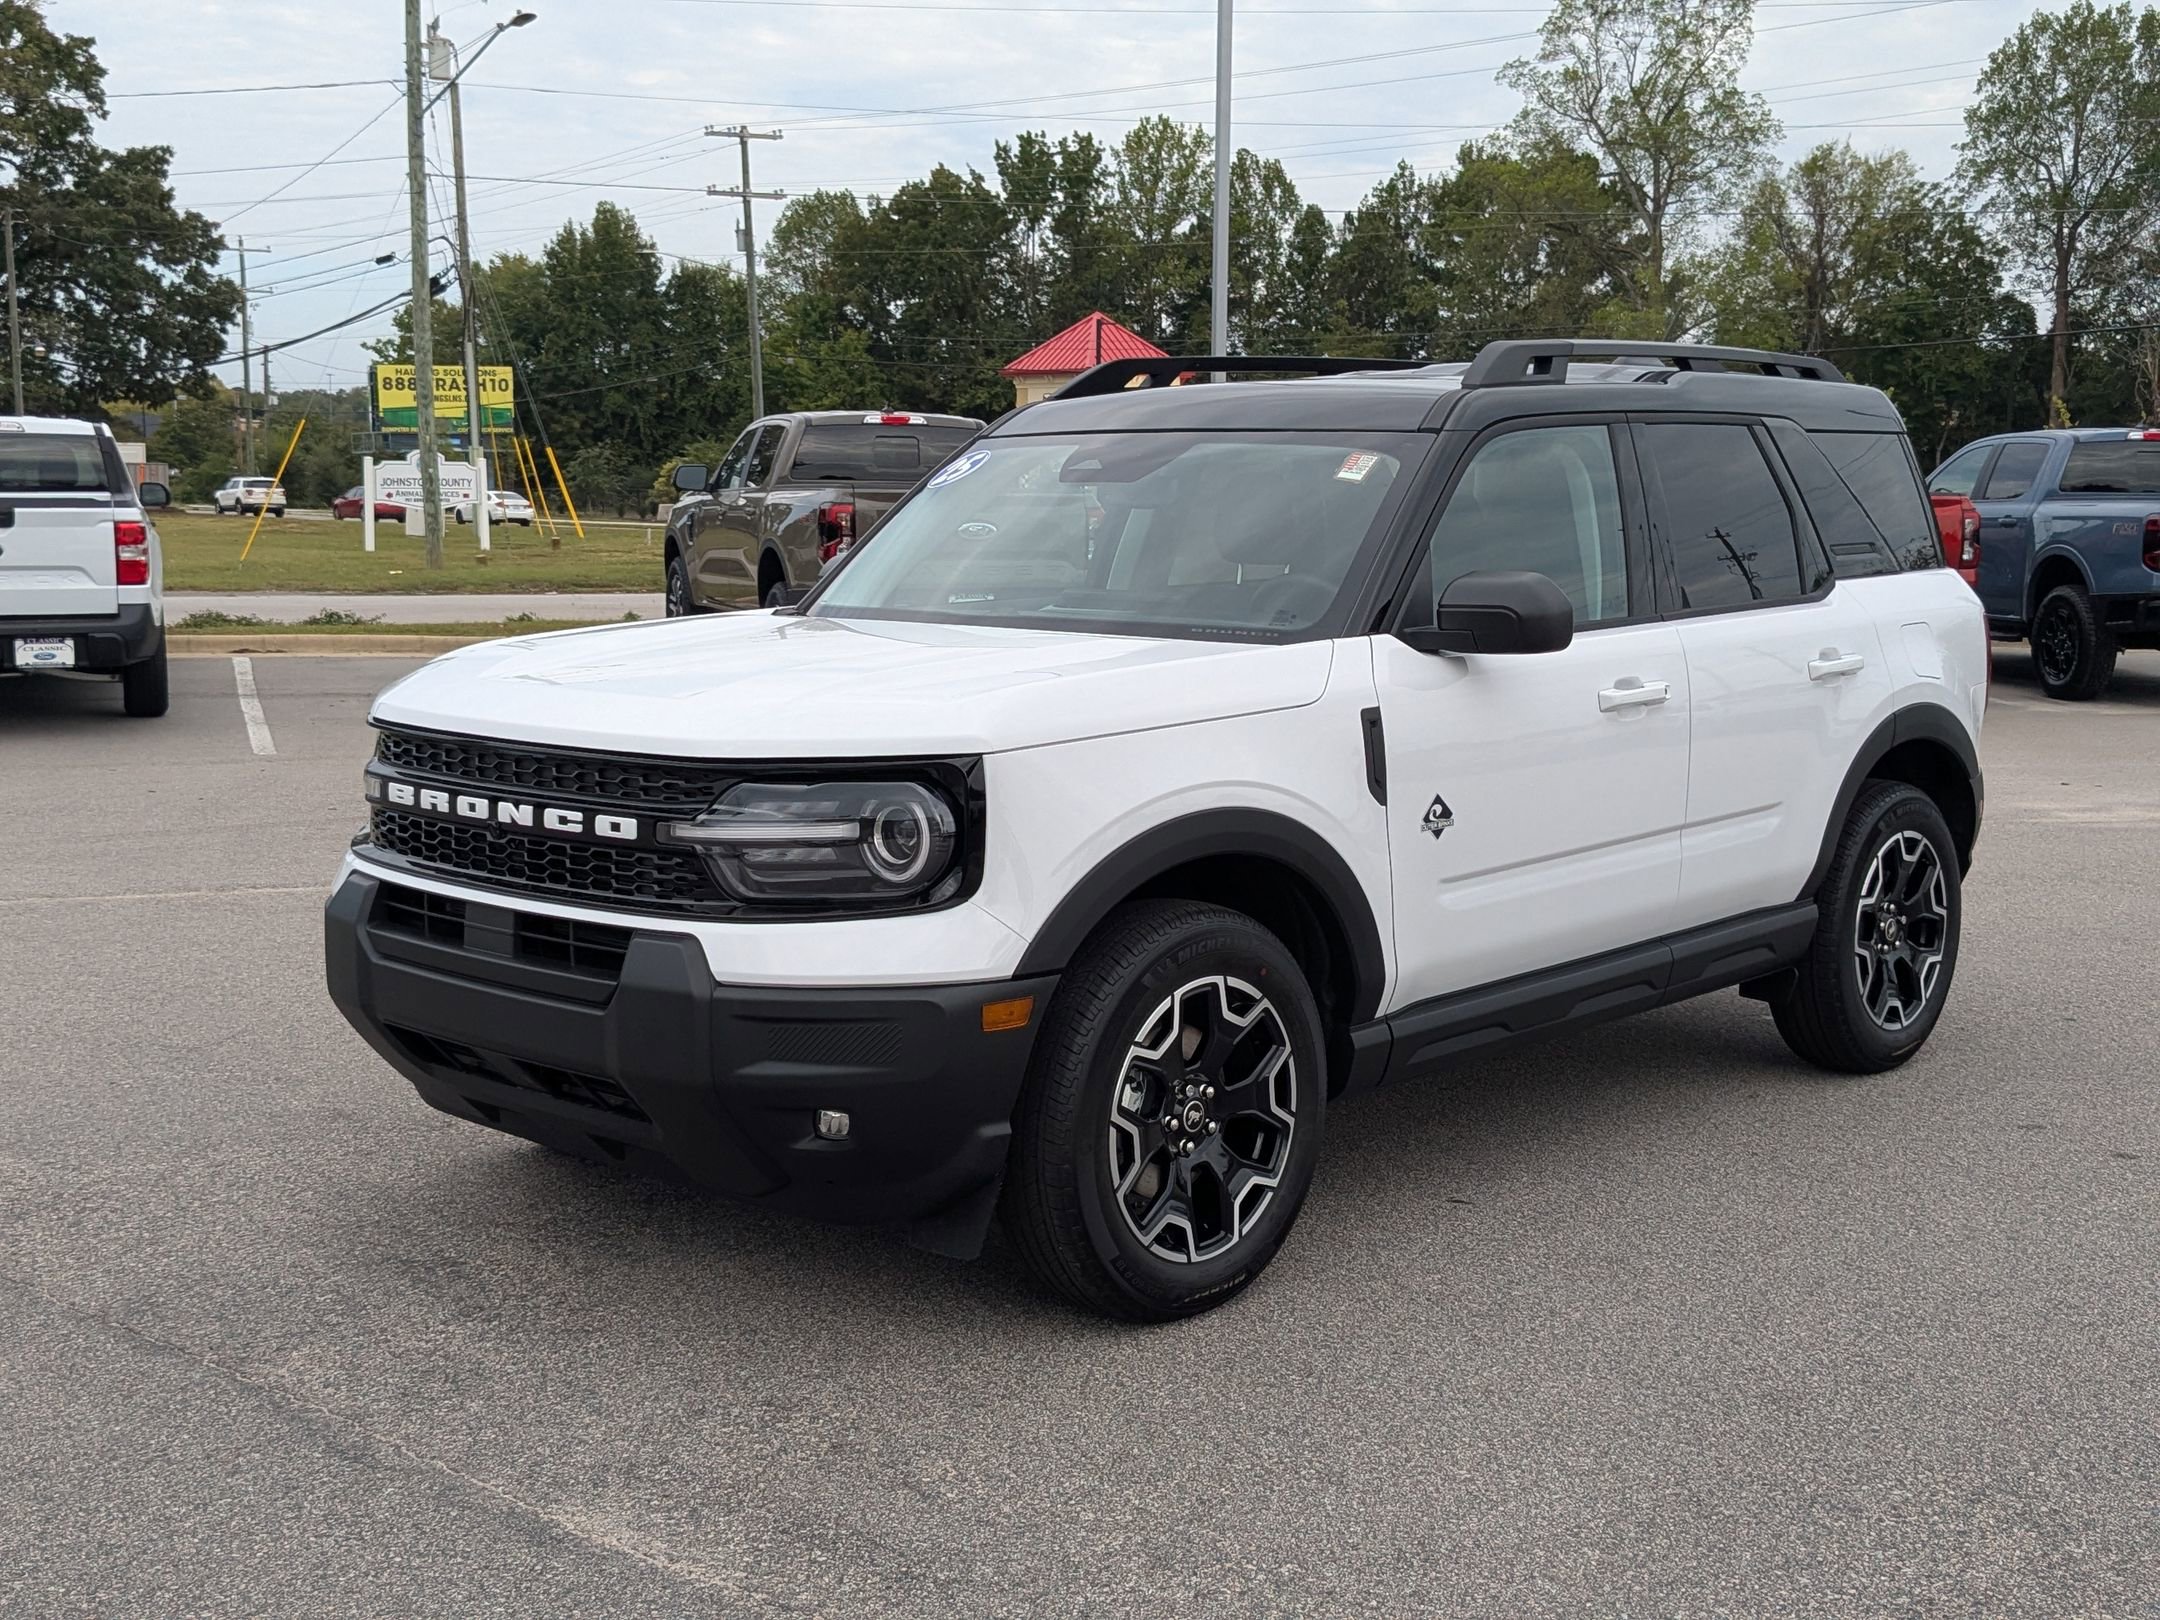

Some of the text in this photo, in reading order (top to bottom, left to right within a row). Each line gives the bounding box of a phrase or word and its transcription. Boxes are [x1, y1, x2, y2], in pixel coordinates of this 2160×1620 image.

[395, 368, 497, 378] HAUG SOLONS
[380, 477, 473, 487] JOHNSTO OUNTY
[388, 782, 638, 840] BRONCO
